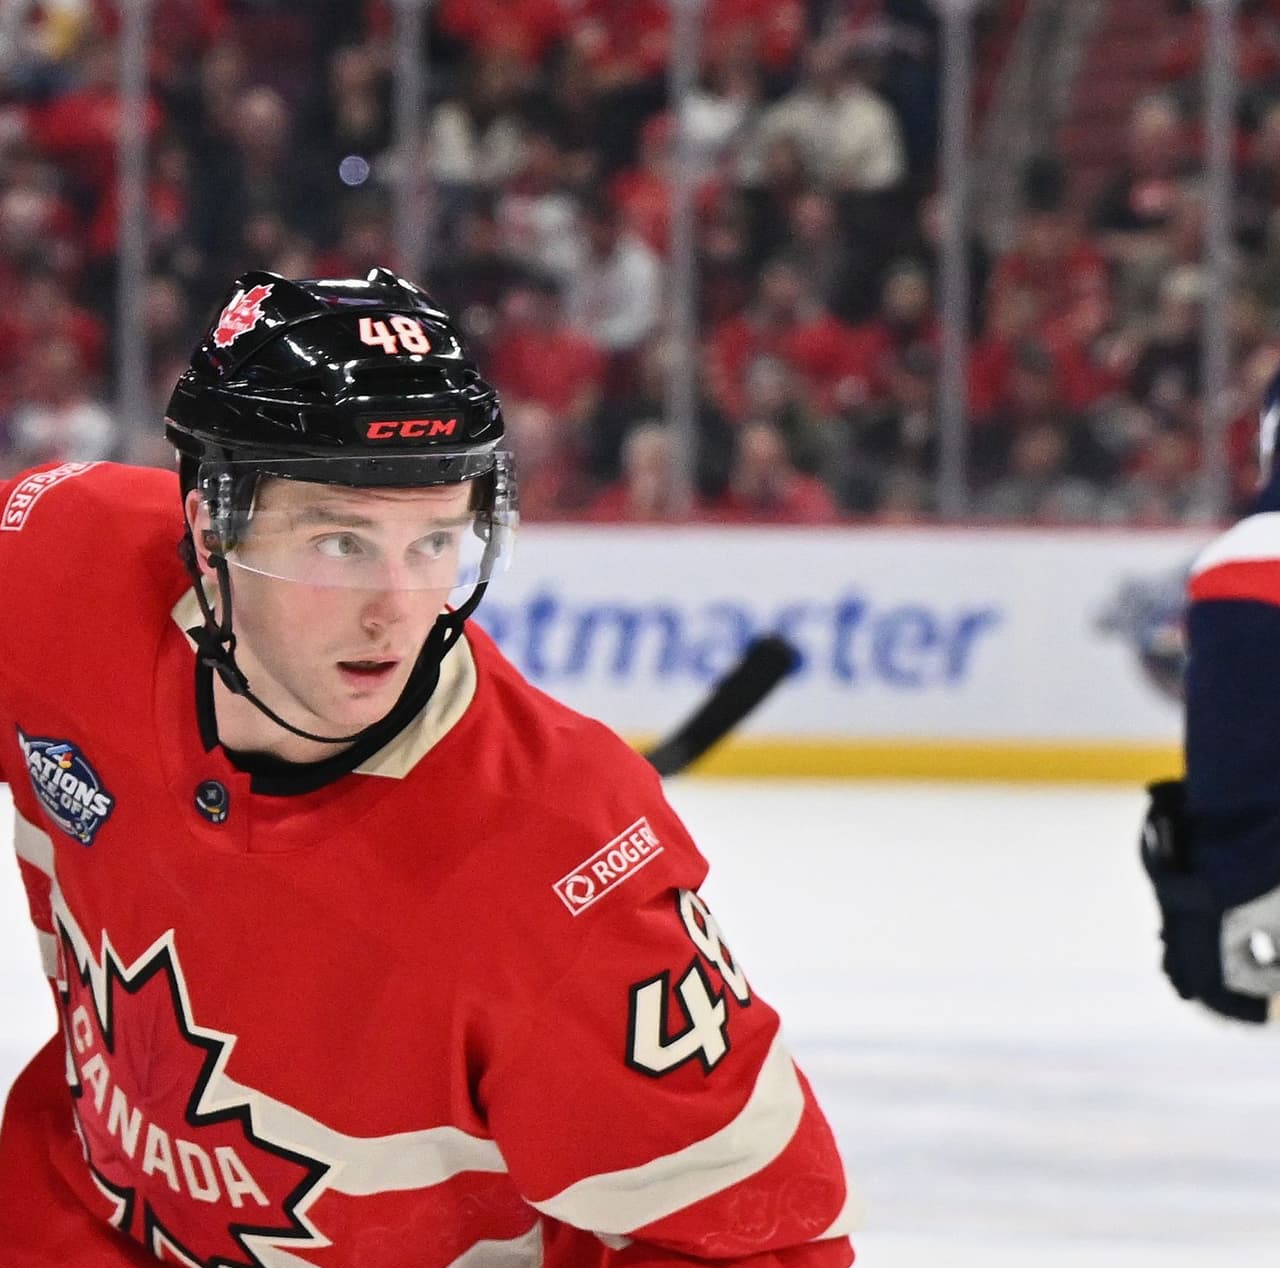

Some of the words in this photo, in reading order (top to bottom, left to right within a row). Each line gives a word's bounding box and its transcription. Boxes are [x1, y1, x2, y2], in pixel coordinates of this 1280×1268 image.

[357, 315, 432, 355] 48
[366, 418, 458, 440] CCM
[591, 825, 660, 886] ROGER
[624, 886, 752, 1079] 48
[71, 1004, 270, 1209] CANADA
